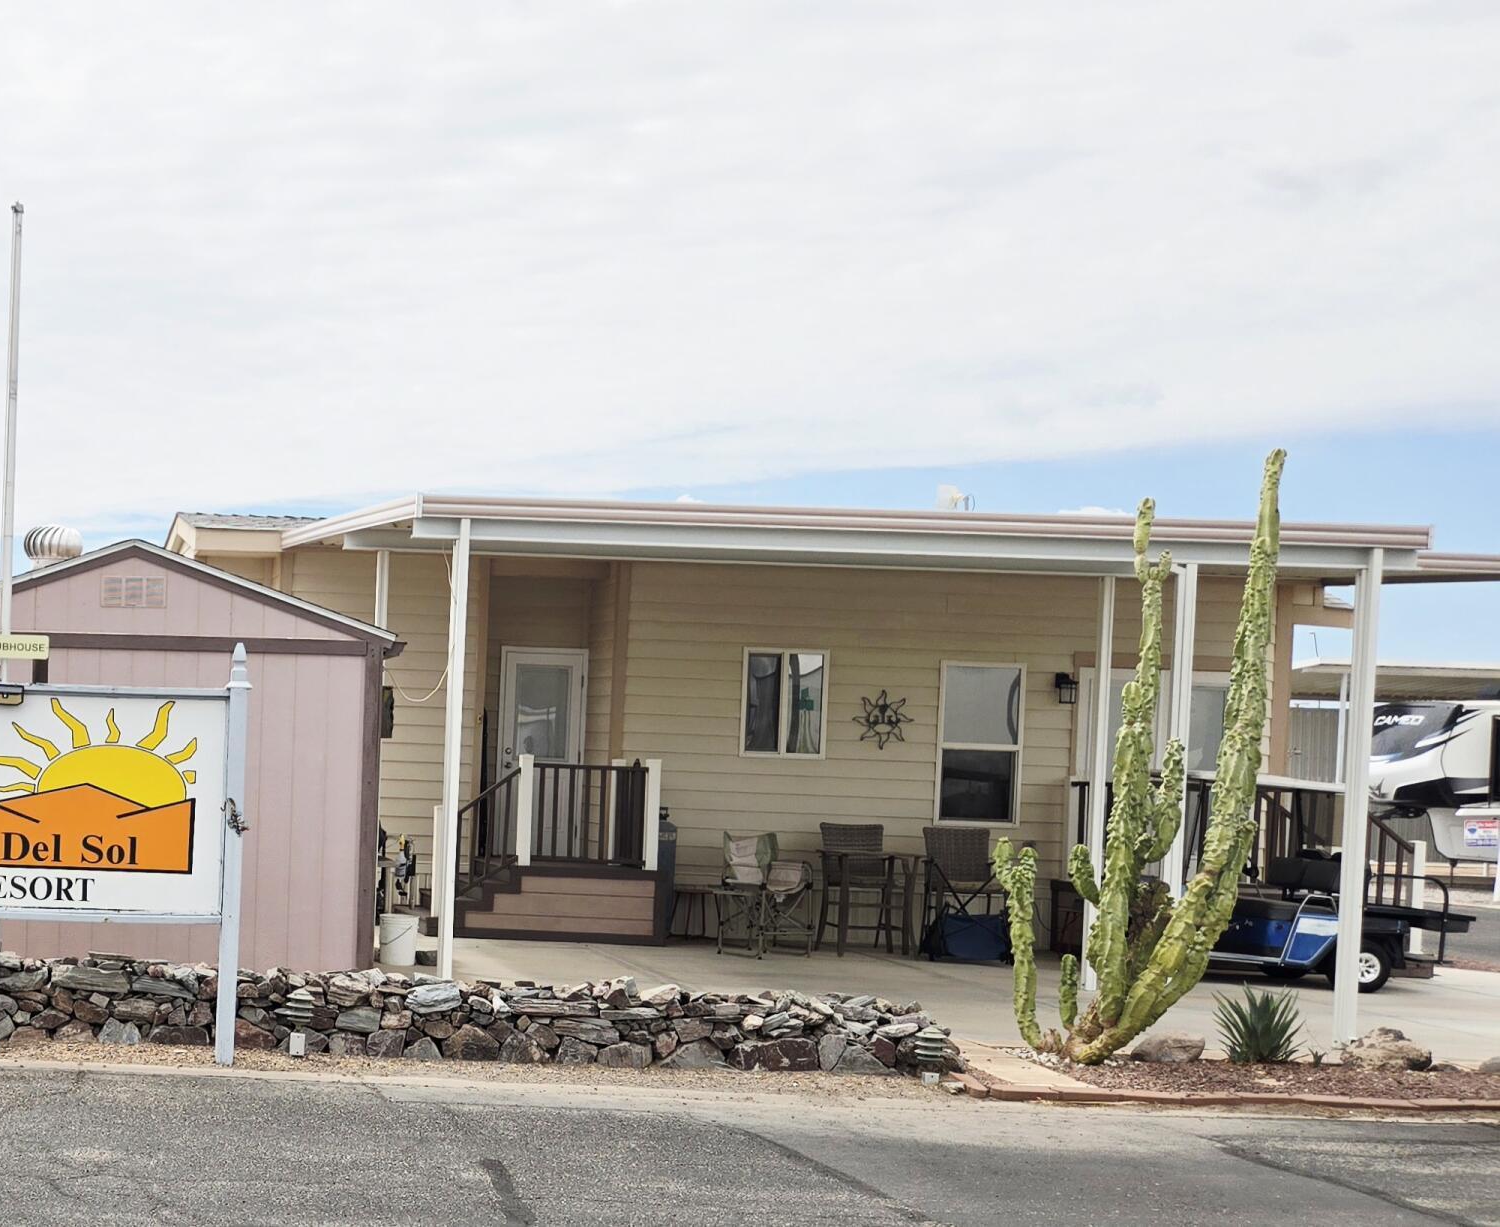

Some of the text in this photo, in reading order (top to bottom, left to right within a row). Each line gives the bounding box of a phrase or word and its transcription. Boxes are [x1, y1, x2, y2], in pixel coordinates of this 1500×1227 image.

[1373, 714, 1425, 727] CAMEO
[0, 831, 63, 863] Del
[80, 834, 139, 865] Sol
